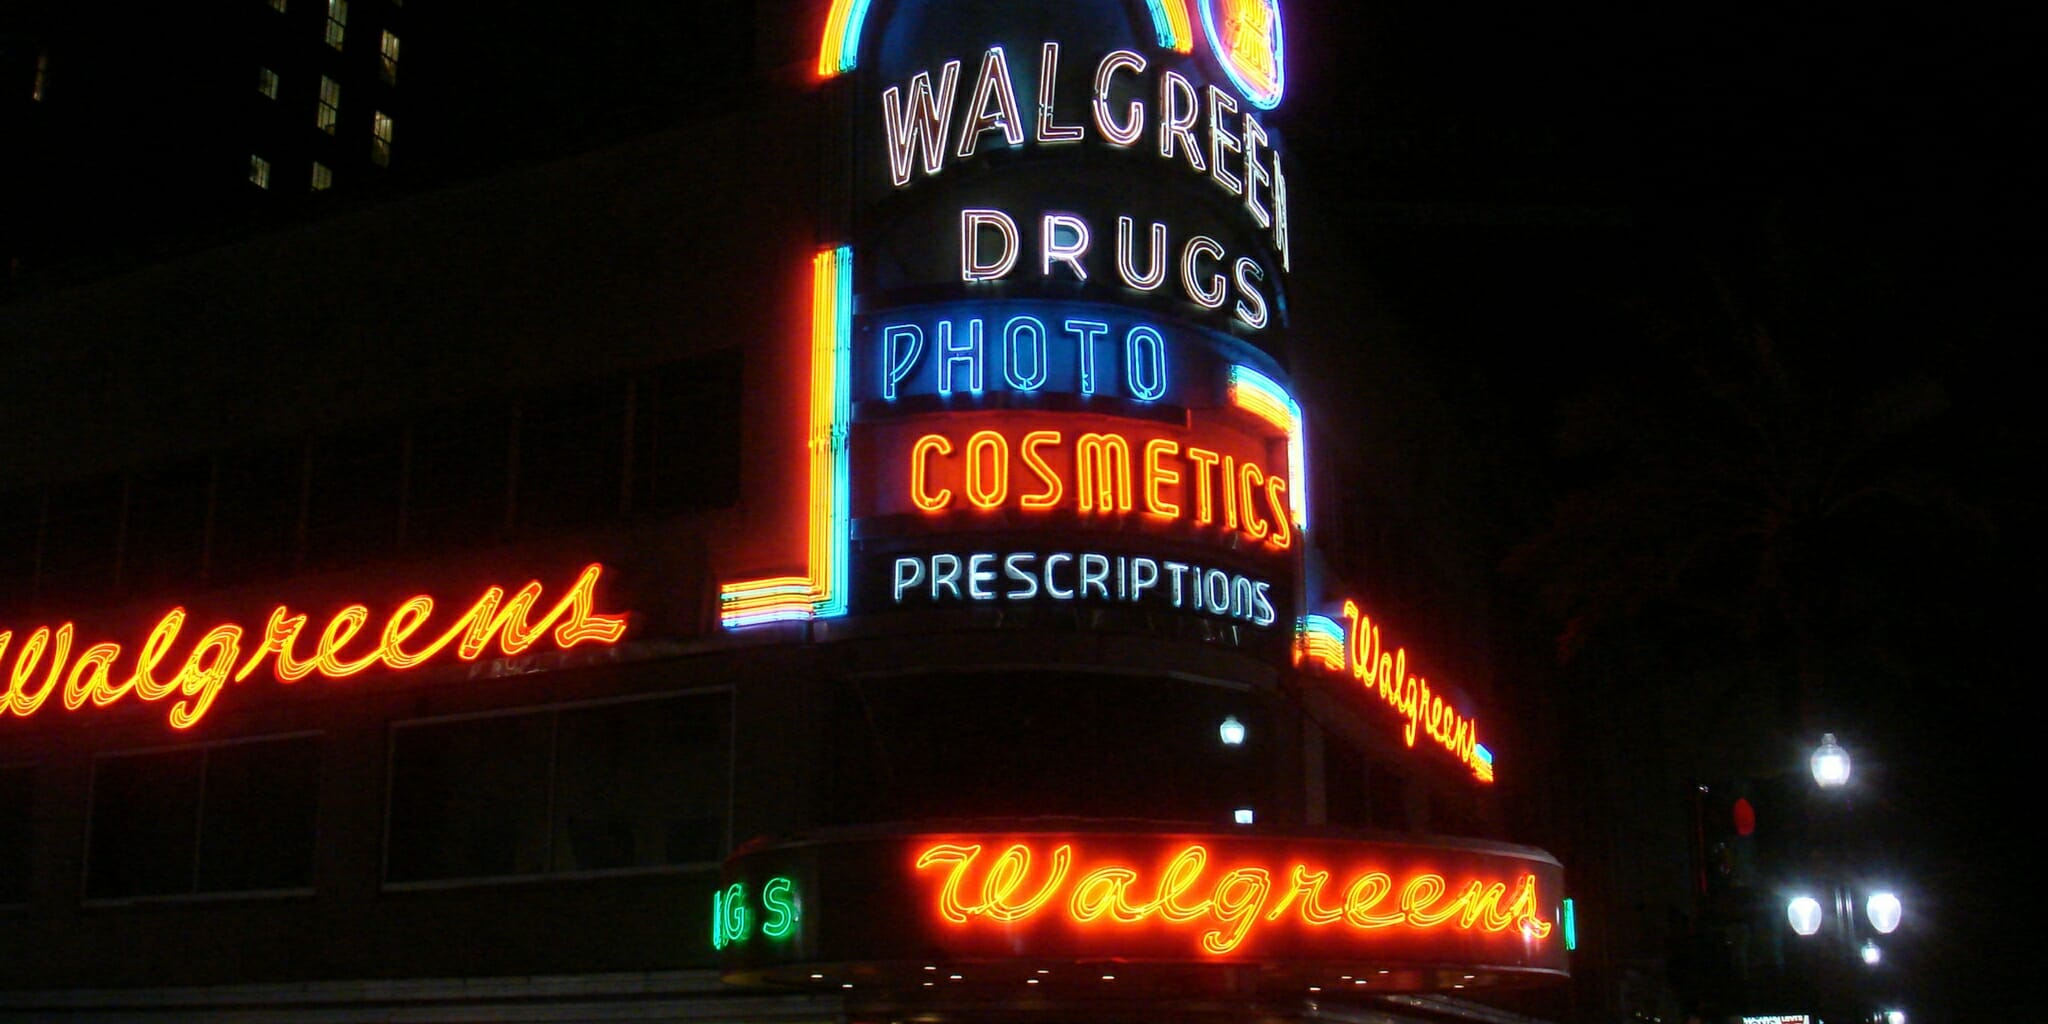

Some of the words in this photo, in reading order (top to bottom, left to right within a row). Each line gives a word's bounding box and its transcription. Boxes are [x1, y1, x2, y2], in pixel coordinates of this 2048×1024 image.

[883, 41, 1290, 273] WALGREEN
[961, 208, 1268, 330] DRUGS
[883, 316, 1168, 400] PHOTO
[911, 430, 1291, 549] COSMETICS
[0, 563, 629, 729] Walgreens
[894, 553, 1276, 626] PRESCRIPTIONS
[916, 844, 1552, 955] Walgreens
